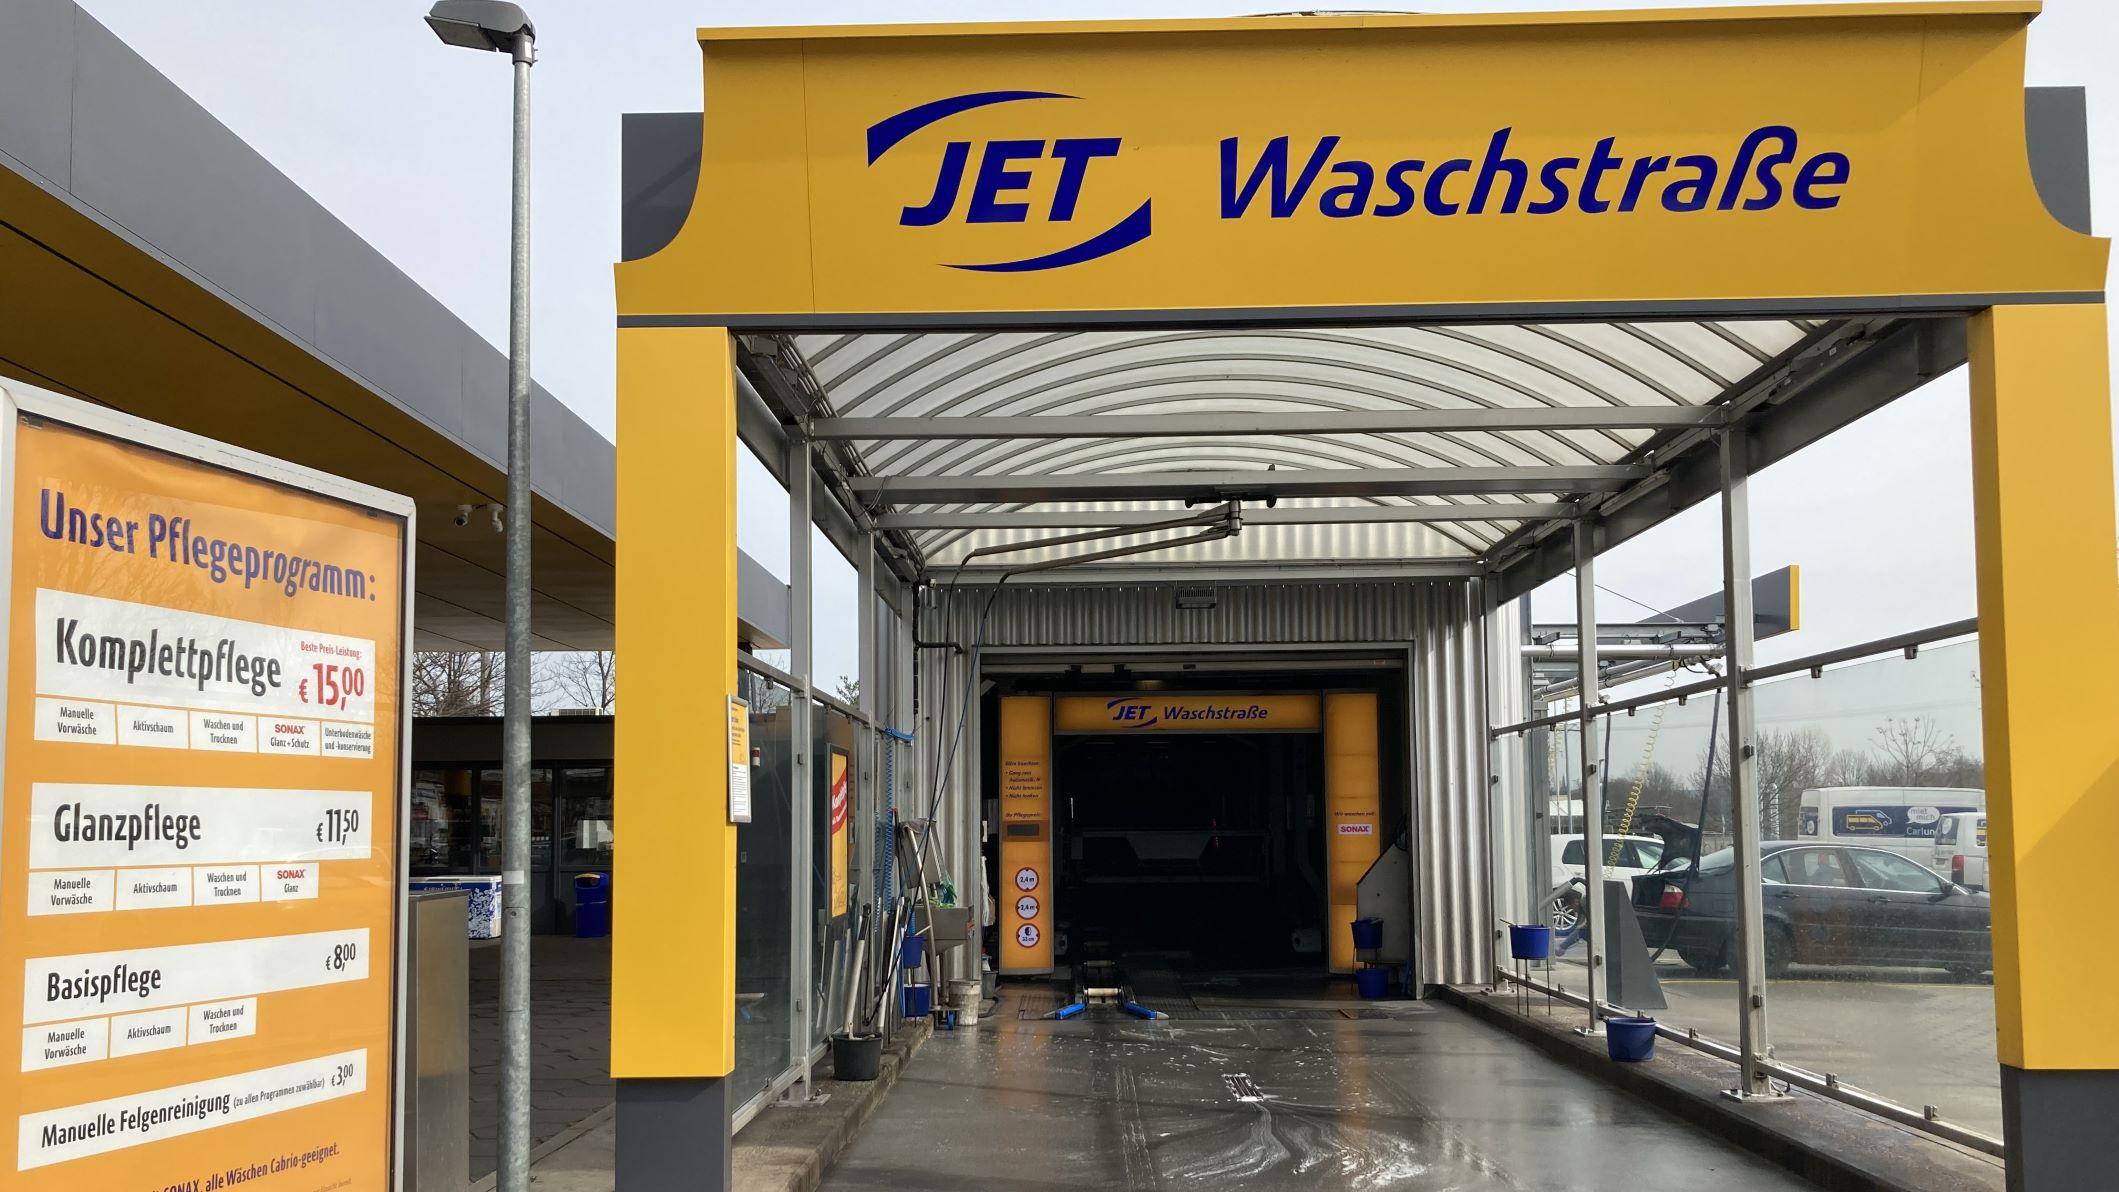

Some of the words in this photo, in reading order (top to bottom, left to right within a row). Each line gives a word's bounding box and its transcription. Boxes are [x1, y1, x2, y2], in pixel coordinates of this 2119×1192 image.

[901, 137, 1121, 226] JET
[1220, 125, 1850, 219] Waschstraße
[40, 488, 139, 554] Unser
[148, 513, 376, 602] Pflegeprogramm:
[300, 641, 318, 653] Beste
[56, 617, 282, 697] Komplettpflege
[59, 706, 95, 720] Manuelle
[1112, 705, 1152, 721] JET
[1163, 705, 1268, 720] Waschstraße
[57, 722, 97, 736] Vorwäsche
[132, 720, 174, 733] Aktivschaum
[203, 719, 231, 731] Waschen
[232, 721, 244, 732] und
[275, 724, 305, 735] SONAX
[210, 733, 238, 745] Trocknen
[324, 727, 372, 740] Unterbodenwäsche
[270, 737, 286, 747] Glanz
[324, 741, 335, 750] und
[53, 802, 201, 851] Glanzpflege
[1340, 825, 1369, 833] SONAX
[1906, 826, 1936, 836] Carlun
[206, 872, 235, 883] Waschen
[235, 871, 247, 882] und
[277, 869, 305, 880] SONAX
[53, 877, 91, 890] Manuelle
[133, 881, 178, 894] Aktivschaum
[284, 883, 299, 893] Glanz
[213, 886, 242, 897] Trocknen
[50, 892, 93, 906] Vorwäsche
[47, 963, 162, 1004] Basispflege
[203, 1007, 231, 1021] Waschen
[232, 1005, 244, 1017] und
[127, 1024, 172, 1040] Aktivschaum
[209, 1021, 238, 1034] Trocknen
[47, 1027, 85, 1044] Manuelle
[44, 1043, 87, 1060] Vorwäsche
[41, 1112, 116, 1148] Manuelle
[120, 1093, 231, 1133] Felgenreinigung
[244, 1093, 259, 1105] allen
[260, 1085, 295, 1102] Programmen
[205, 1172, 225, 1192] alle
[225, 1163, 268, 1186] Wäschen
[270, 1142, 340, 1175] Cabrio-geeignet.
